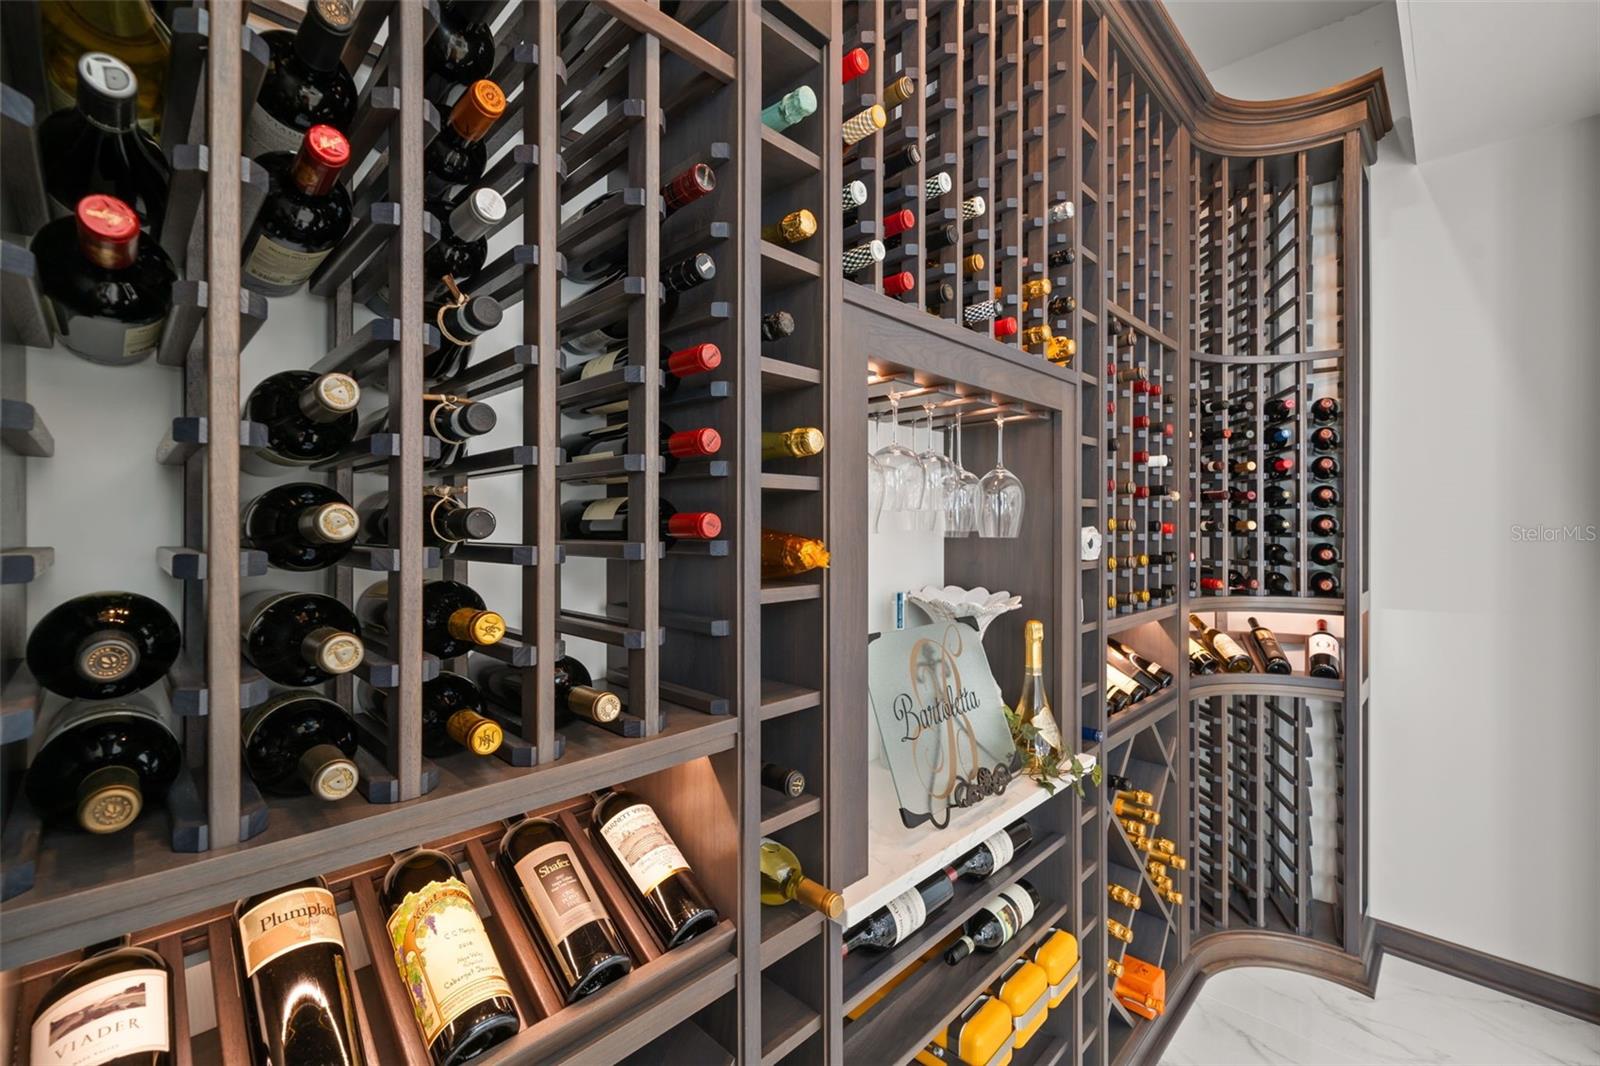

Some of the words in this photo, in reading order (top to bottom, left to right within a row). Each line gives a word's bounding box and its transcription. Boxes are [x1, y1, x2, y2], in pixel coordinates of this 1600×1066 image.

[893, 685, 981, 743] Bartoletta
[539, 859, 571, 878] Shafer
[55, 1017, 140, 1059] VIADER
